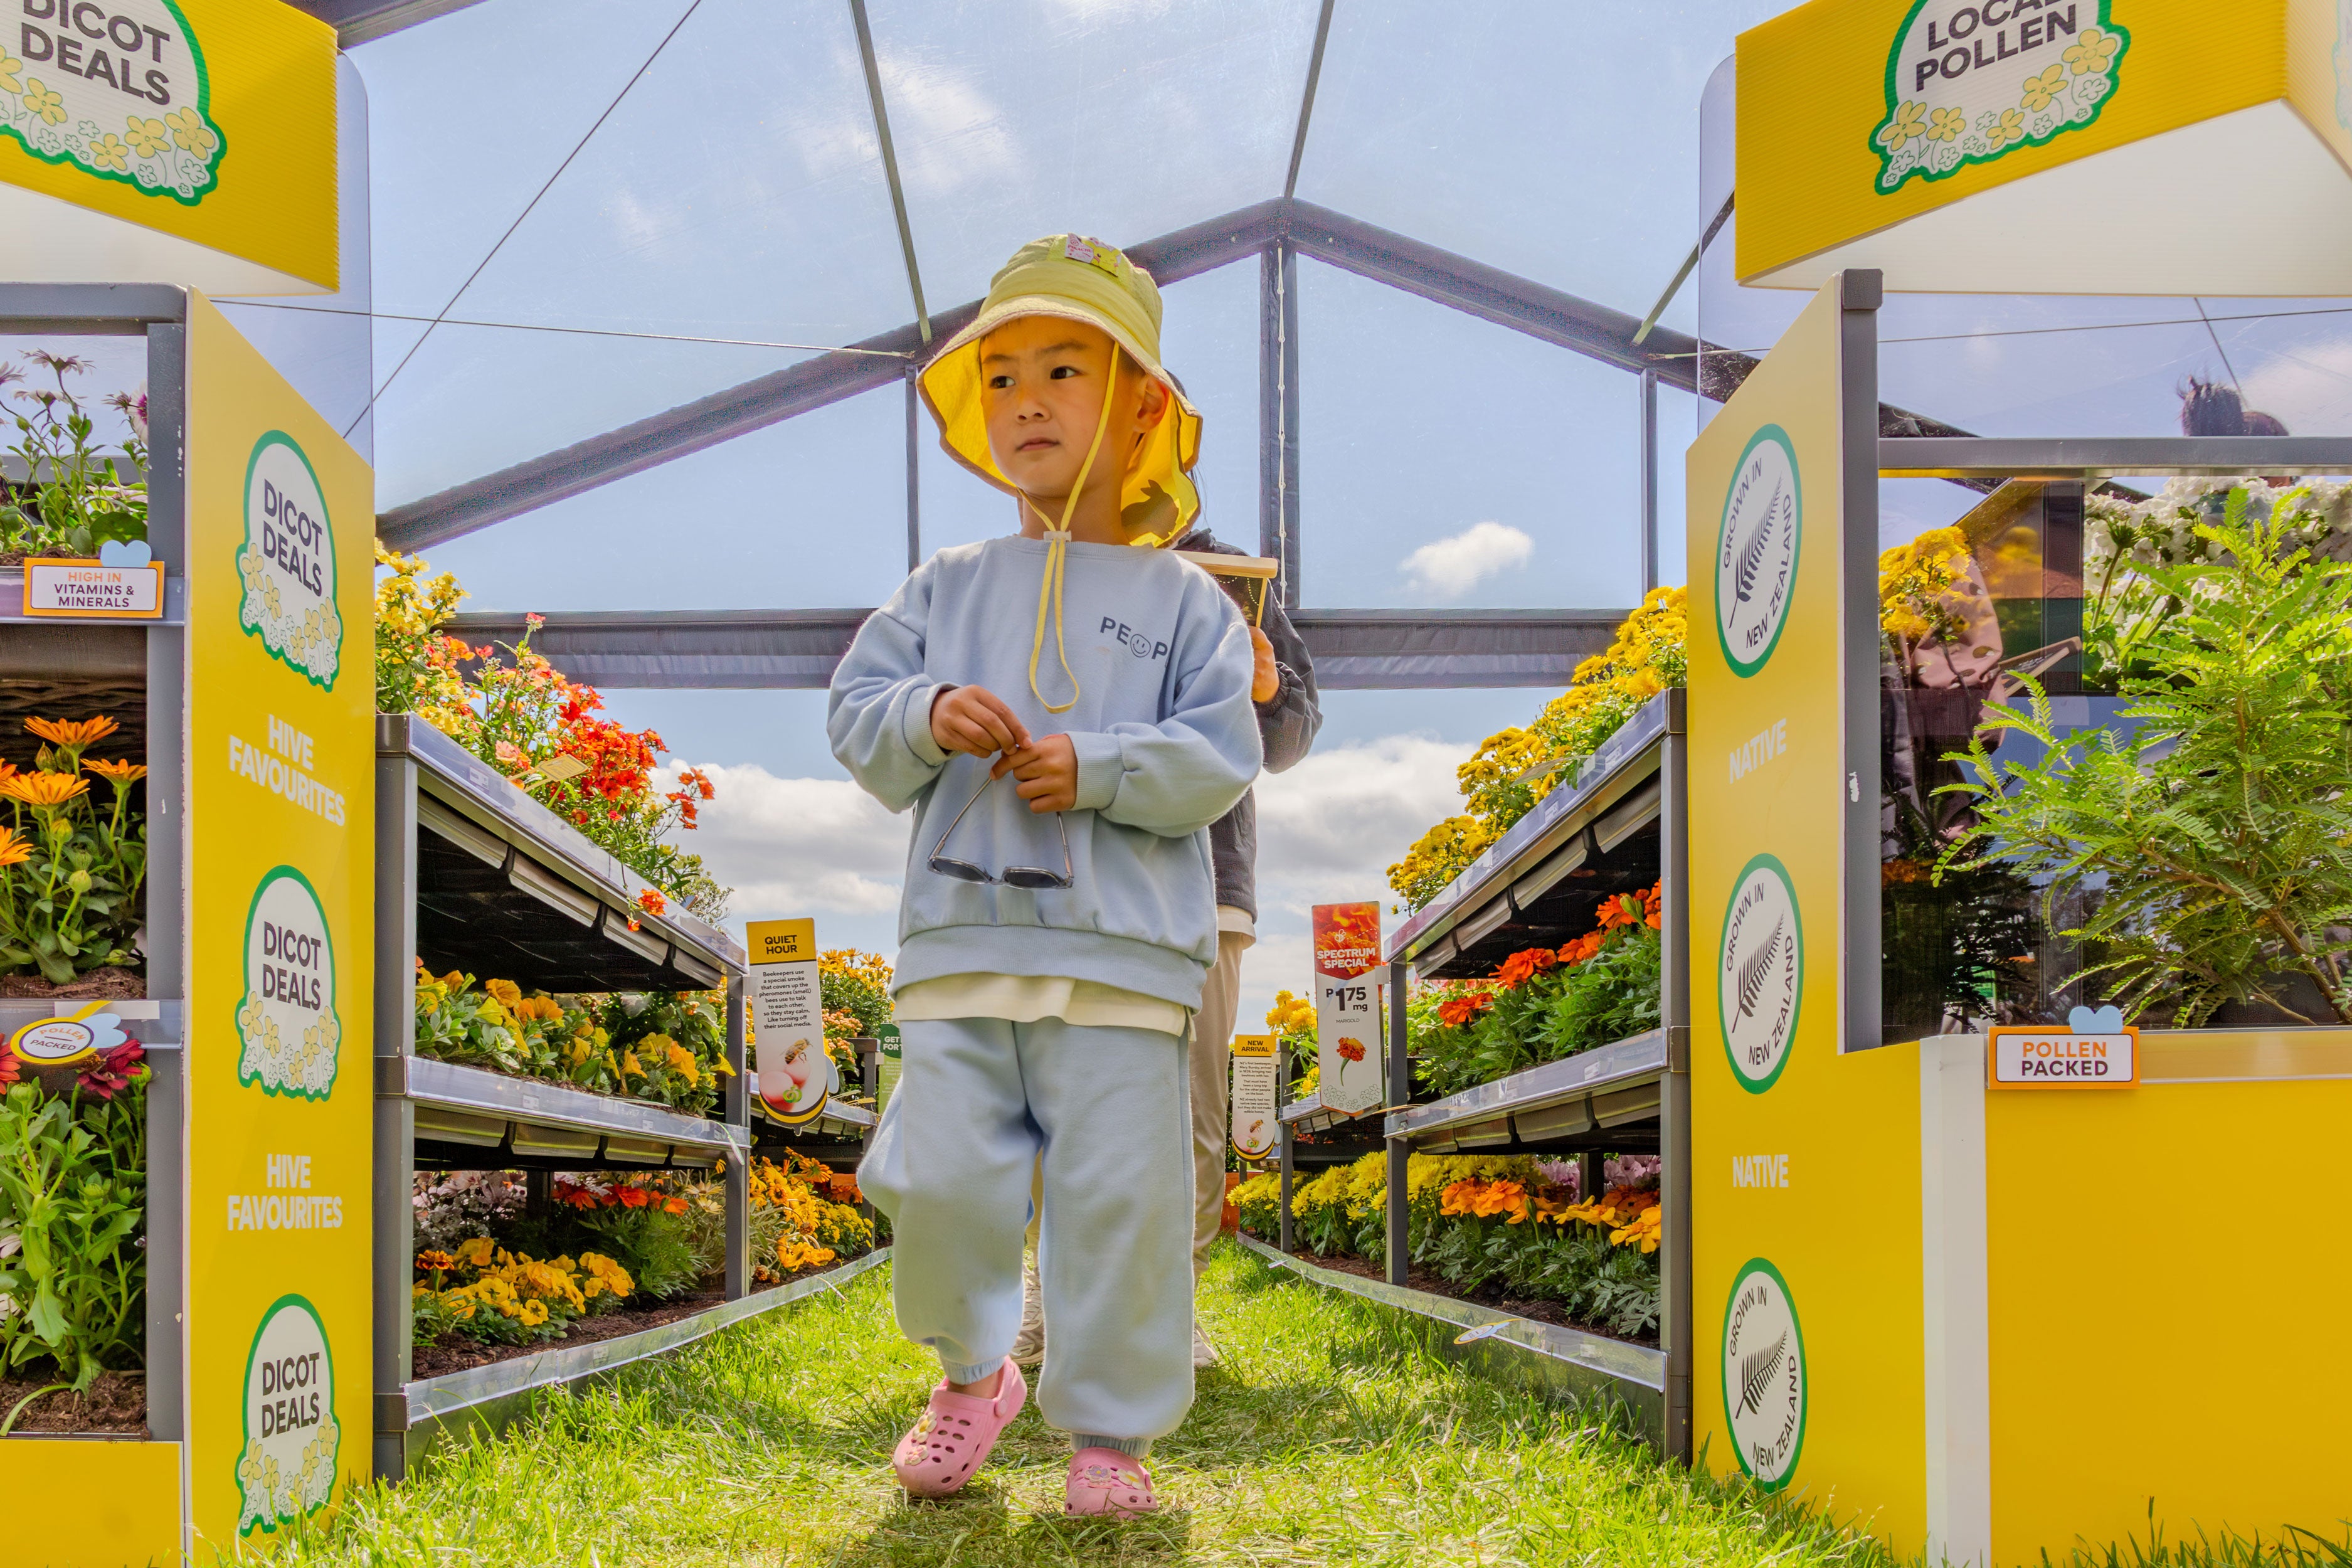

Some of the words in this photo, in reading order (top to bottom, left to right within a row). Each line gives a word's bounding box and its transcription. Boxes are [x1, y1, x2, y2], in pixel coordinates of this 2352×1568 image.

[1916, 4, 2076, 92] POLLEN
[1928, 0, 2062, 51] LOCA
[21, 22, 170, 105] DEALS
[264, 479, 322, 556] DICOT
[1724, 475, 1749, 568] GROWN
[1751, 458, 1762, 484] IN
[68, 572, 103, 582] HIGH
[107, 573, 122, 583] IN
[263, 520, 322, 597] DEALS
[1746, 613, 1768, 649] NEW
[1769, 493, 1792, 617] ZEALAND
[54, 584, 122, 595] VITAMINS
[126, 585, 134, 595] &
[58, 596, 129, 607] MINERALS
[268, 714, 314, 771] HIVE
[1729, 718, 1786, 784] NATIVE
[229, 734, 346, 827] FAVOURITES
[263, 920, 321, 971] DICOT
[765, 935, 797, 945] QUIET
[766, 945, 798, 955] HOUR
[1727, 891, 1752, 972] GROWN
[1754, 882, 1764, 904] IN
[1317, 947, 1375, 960] SPECTRUM
[1324, 958, 1369, 969] SPECIAL
[263, 963, 321, 1011] DEALS
[1749, 1040, 1770, 1065] NEW
[1772, 935, 1793, 1047] ZEALAND
[30, 1039, 77, 1051] PACKED
[40, 1028, 85, 1041] POLLEN
[2023, 1042, 2107, 1058] POLLEN
[2021, 1060, 2108, 1076] PACKED
[267, 1153, 311, 1189] HIVE
[1732, 1154, 1789, 1188] NATIVE
[228, 1194, 343, 1231] FAVOURITES
[1730, 1287, 1754, 1357] GROWN
[1757, 1285, 1767, 1307] IN
[262, 1352, 320, 1396] DICOT
[262, 1392, 320, 1439] DEALS
[1752, 1441, 1774, 1467] NEW
[1776, 1355, 1797, 1460] ZEALAND
